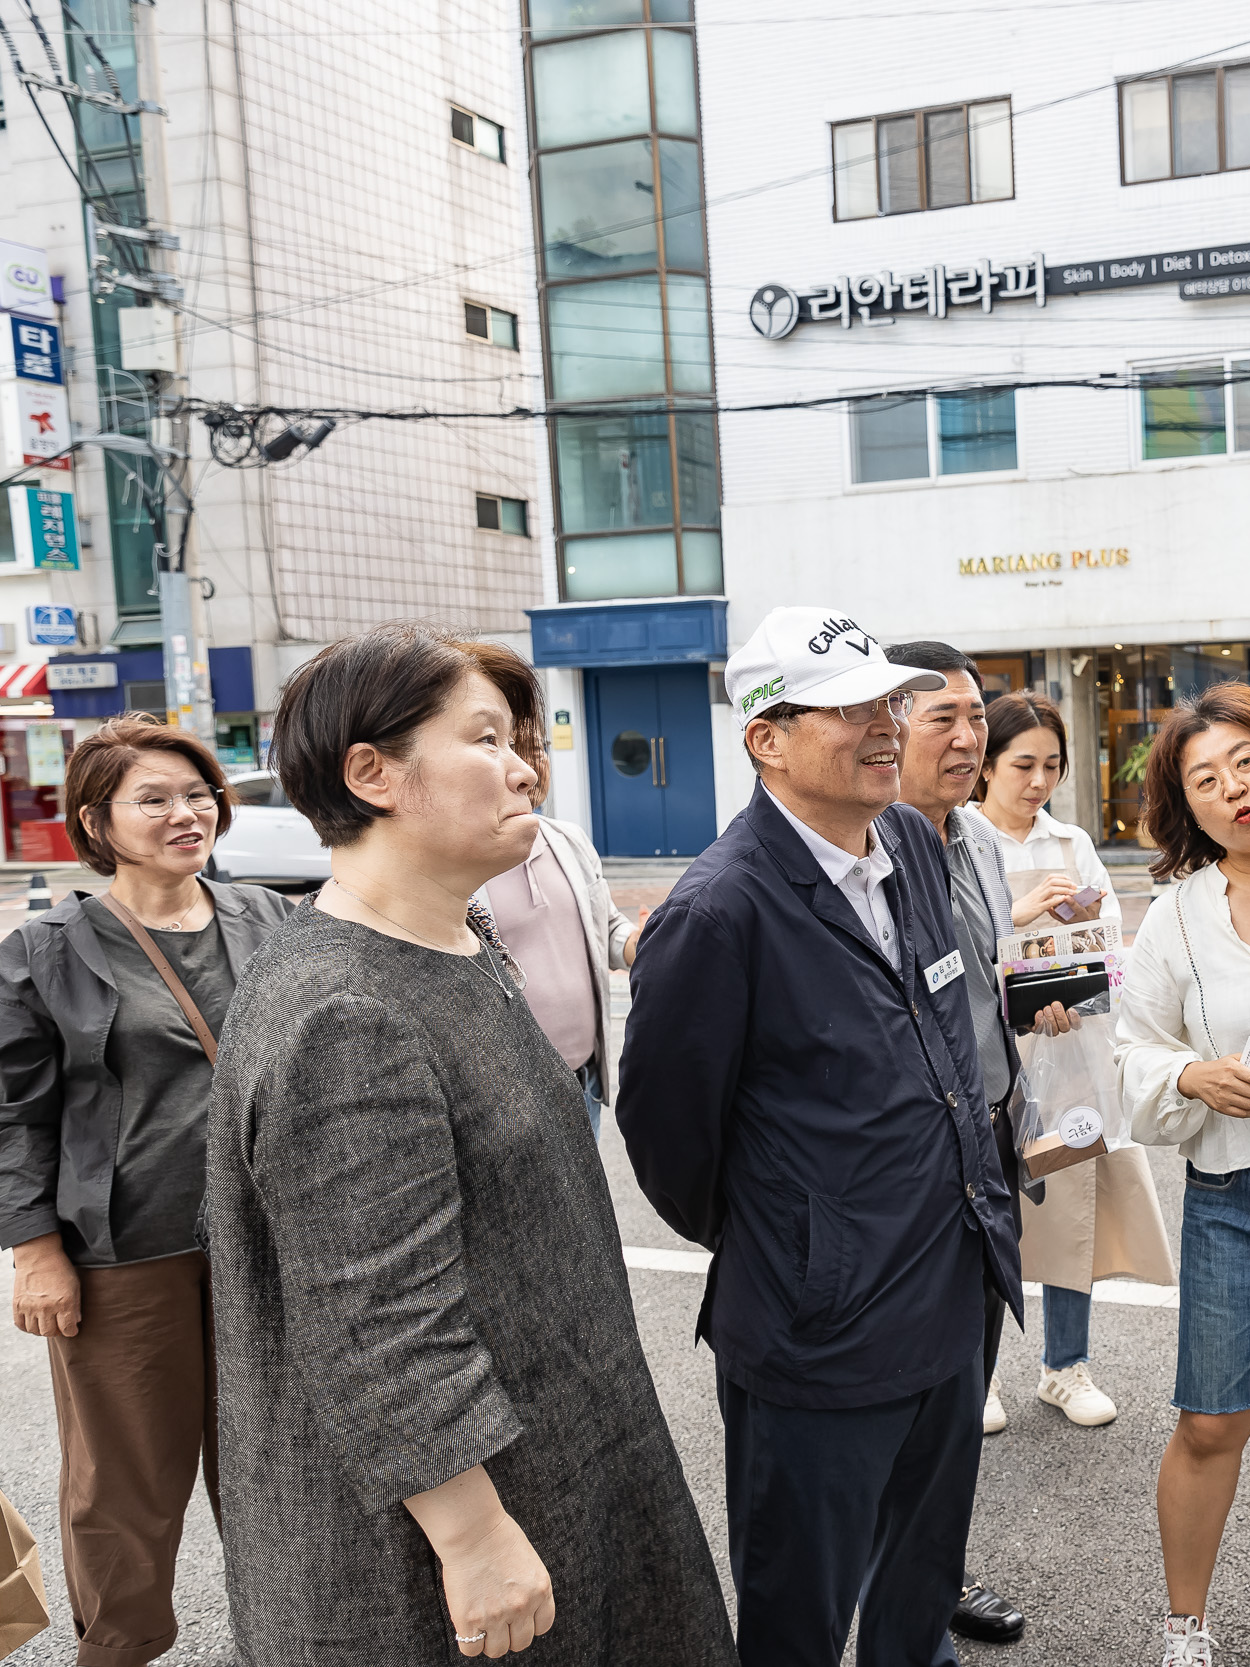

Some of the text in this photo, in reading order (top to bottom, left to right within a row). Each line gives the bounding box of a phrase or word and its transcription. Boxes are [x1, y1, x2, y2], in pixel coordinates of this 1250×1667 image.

[14, 270, 38, 285] CU
[1063, 268, 1093, 285] Skin
[1110, 261, 1145, 279] Body
[1162, 256, 1192, 273] Diet
[808, 251, 1046, 329] 리안테라피
[958, 547, 1131, 577] MARIANG PLUS
[741, 675, 786, 714] EPIC
